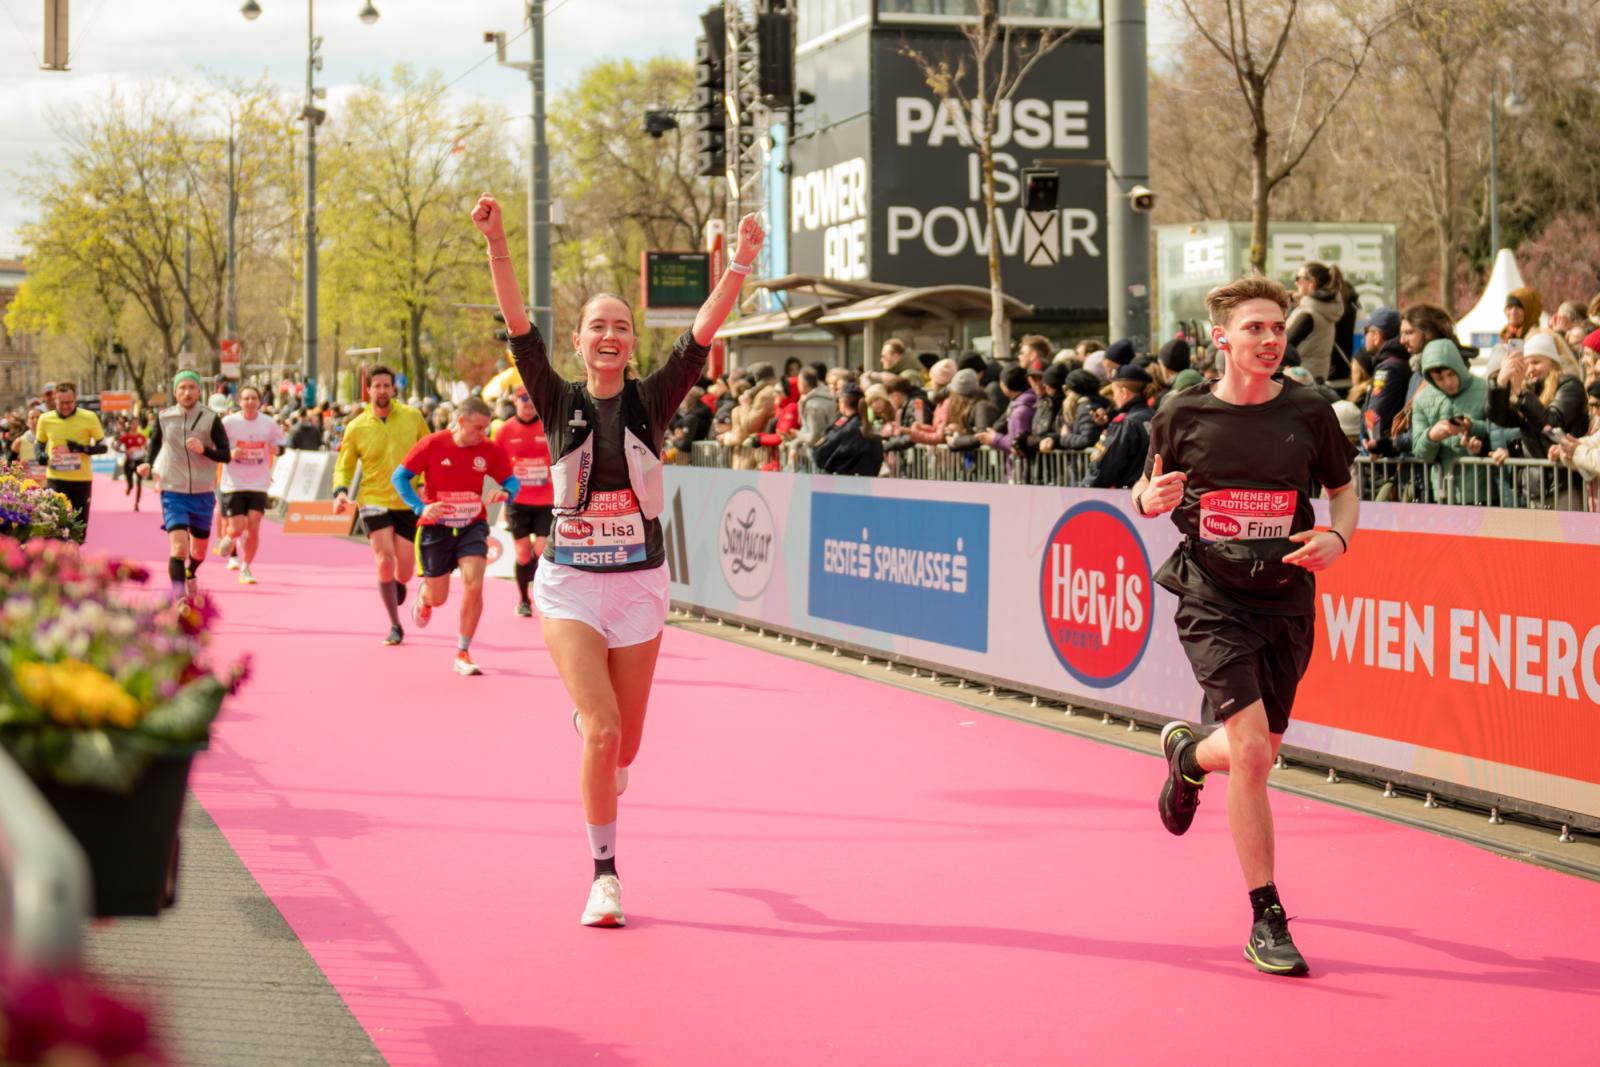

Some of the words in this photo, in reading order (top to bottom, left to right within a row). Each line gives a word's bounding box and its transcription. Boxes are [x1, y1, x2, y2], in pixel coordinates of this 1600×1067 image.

[896, 96, 1090, 149] PAUSE
[791, 157, 868, 234] POWER
[968, 152, 1021, 202] IS
[823, 218, 868, 281] ADE
[887, 206, 1100, 258] POWR
[587, 502, 618, 511] TISCHE
[591, 493, 618, 503] ENER
[1230, 490, 1271, 501] WIENER
[601, 522, 635, 537] Lisa
[723, 507, 772, 575] SanLucar
[1206, 517, 1239, 533] Hervis
[1247, 521, 1283, 537] Finn
[572, 551, 613, 564] ERSTE
[823, 537, 858, 577] ERSTE
[874, 545, 951, 591] SPARKASSE
[1051, 543, 1144, 646] Hervis
[1058, 628, 1101, 651] SPORTS
[1321, 593, 1435, 678] WIEN
